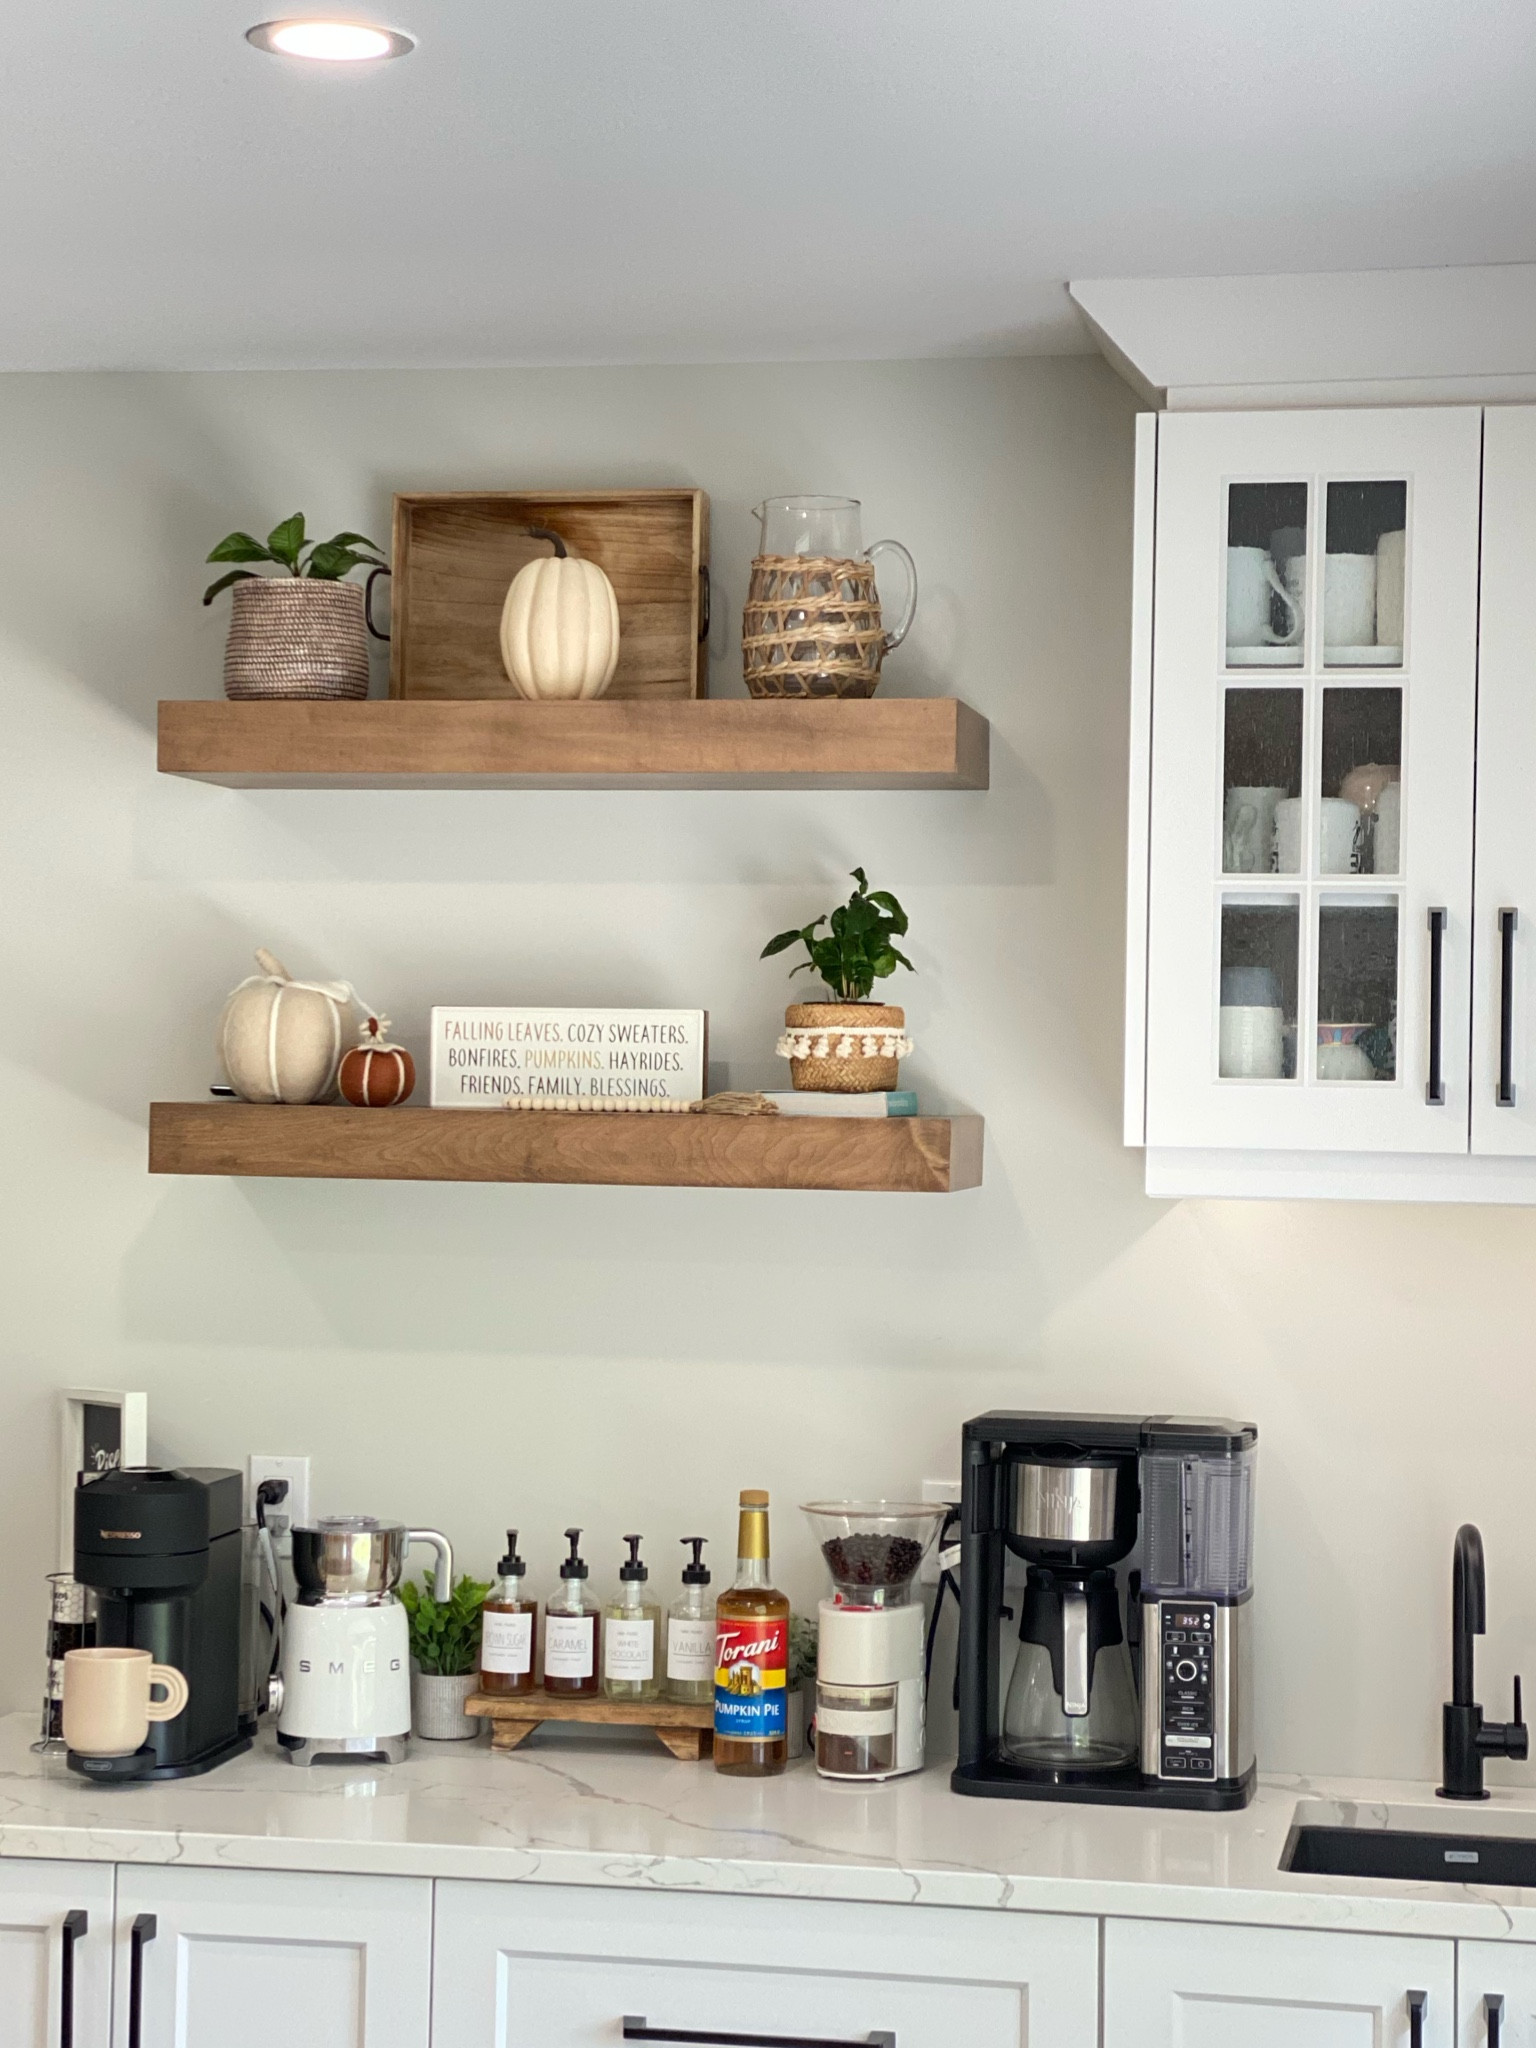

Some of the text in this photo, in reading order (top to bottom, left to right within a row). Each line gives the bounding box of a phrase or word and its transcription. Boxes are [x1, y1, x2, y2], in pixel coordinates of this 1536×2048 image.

[445, 1021, 689, 1044] FALLING LEAVES. COZY SWEATERS.
[448, 1048, 684, 1071] BONFIRES. PUMPKINS. HAYRIDES.
[460, 1075, 670, 1098] FRIENDS. FAMILY. BLESSINGS.
[548, 1638, 588, 1650] CARAMEL
[672, 1640, 712, 1654] VANILLA
[716, 1630, 779, 1669] Torani
[299, 1659, 401, 1675] SMEG
[715, 1700, 780, 1717] PUMPKIN PIE
